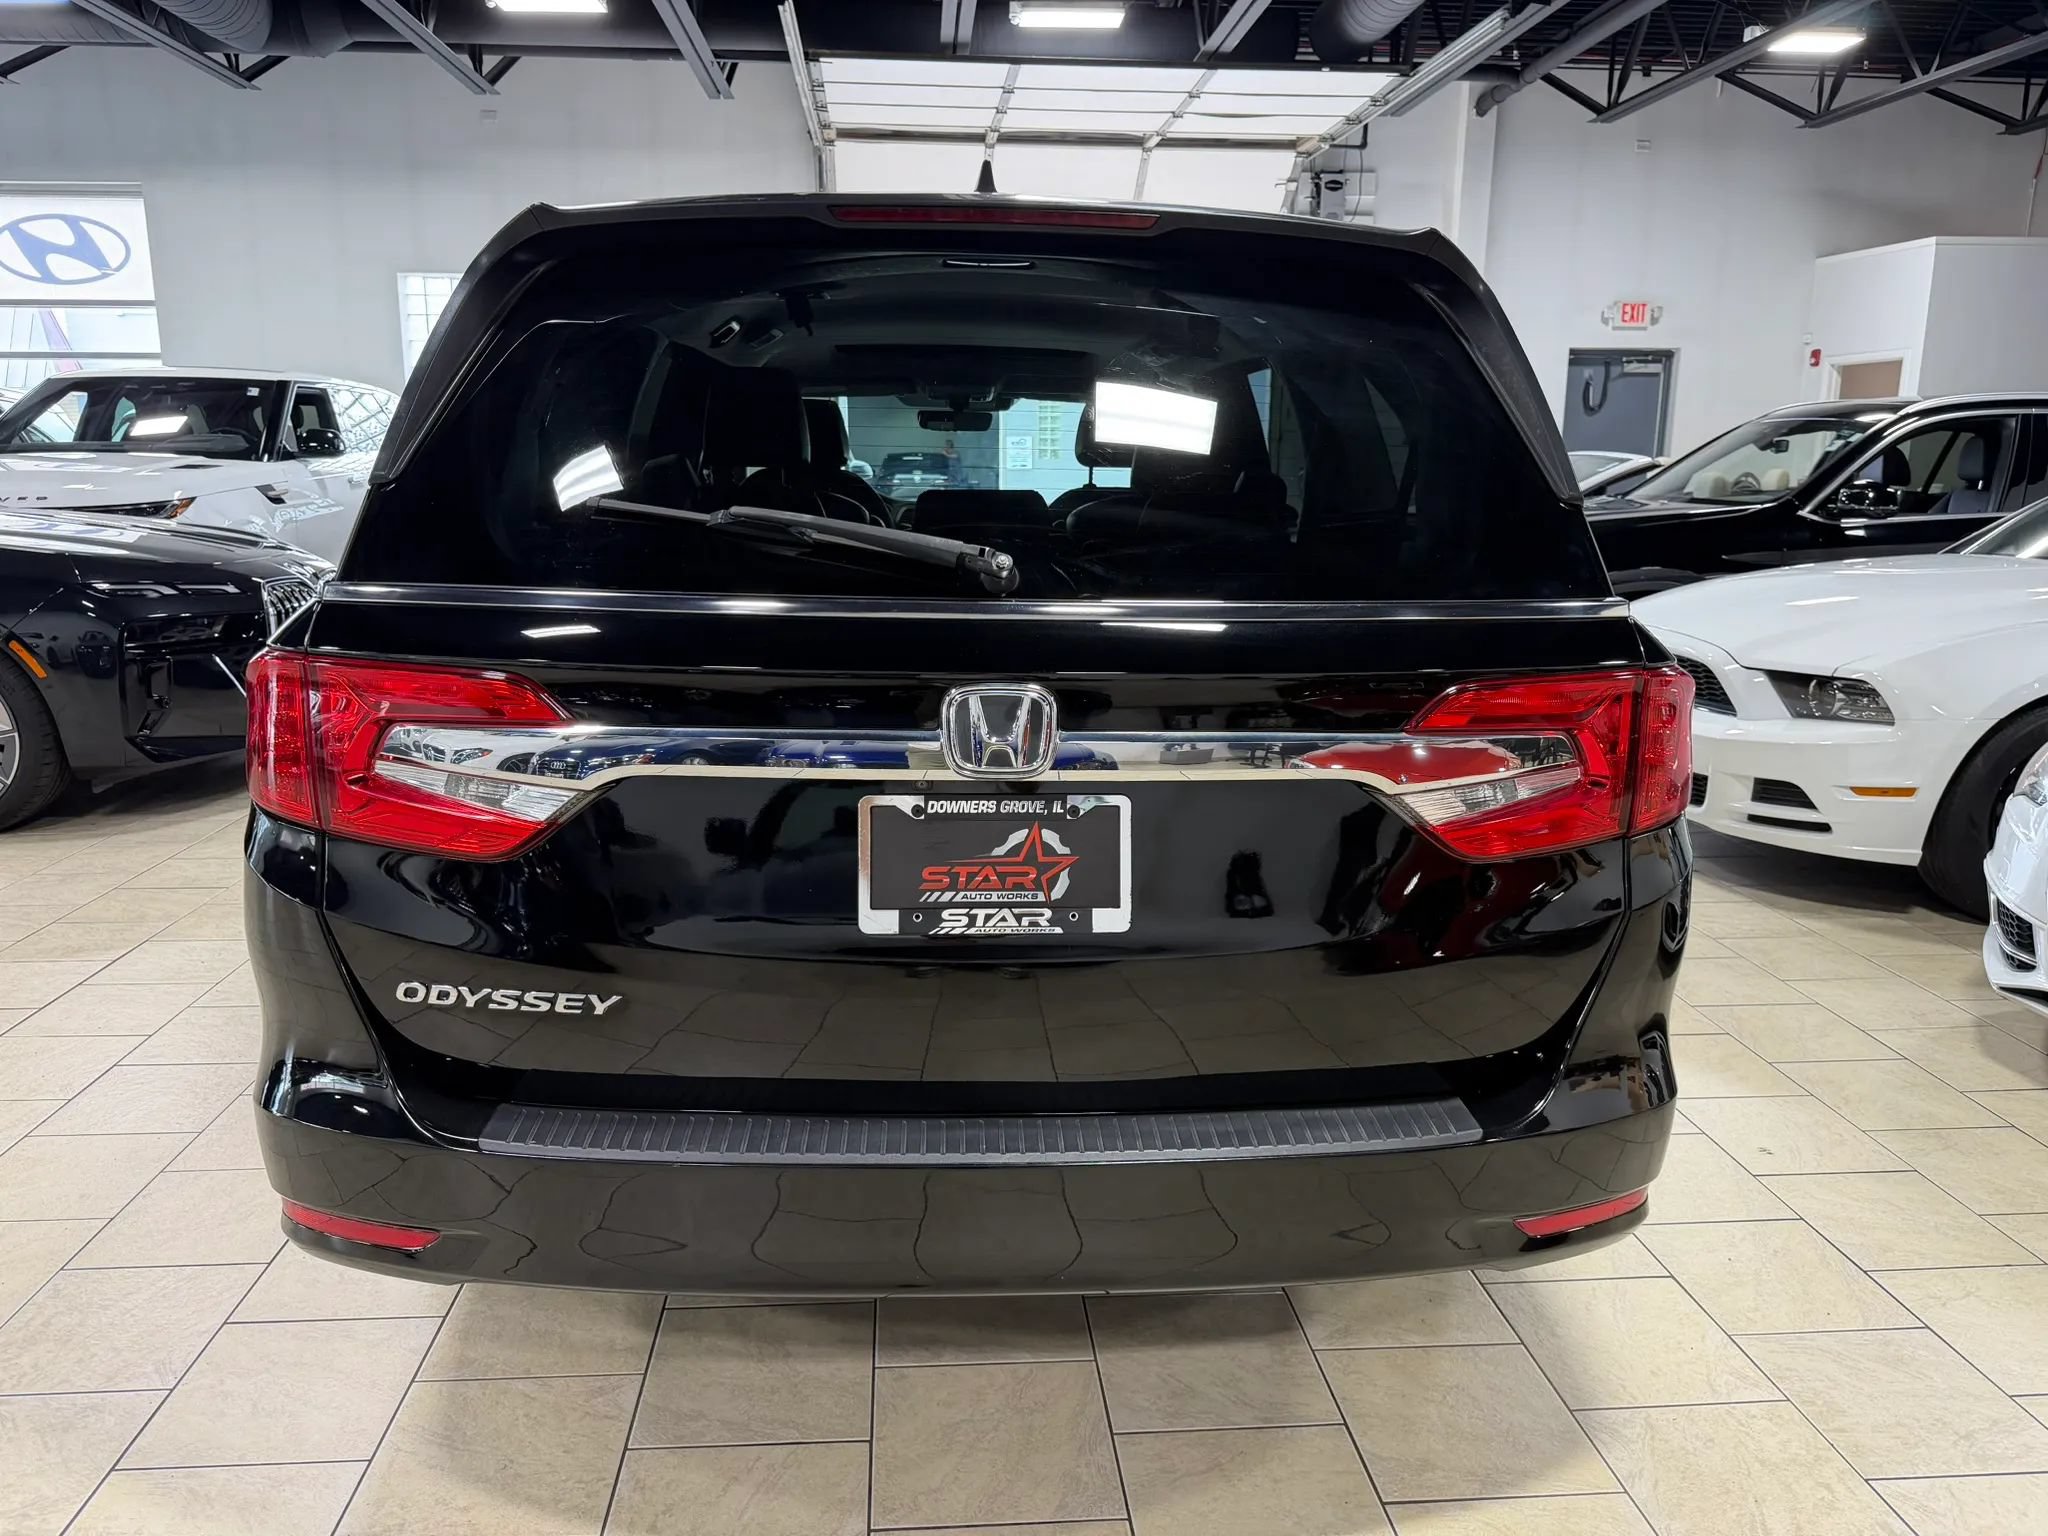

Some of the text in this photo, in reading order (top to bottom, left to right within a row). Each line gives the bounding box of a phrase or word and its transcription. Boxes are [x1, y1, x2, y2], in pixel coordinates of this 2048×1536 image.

[1622, 303, 1648, 323] EXIT
[927, 800, 1065, 815] DOWNERS GROVE, IL
[918, 865, 1038, 890] STAR
[961, 892, 1039, 900] AUTO WORKS
[939, 907, 1053, 928] STAR
[395, 980, 624, 1015] ODYSSEY
